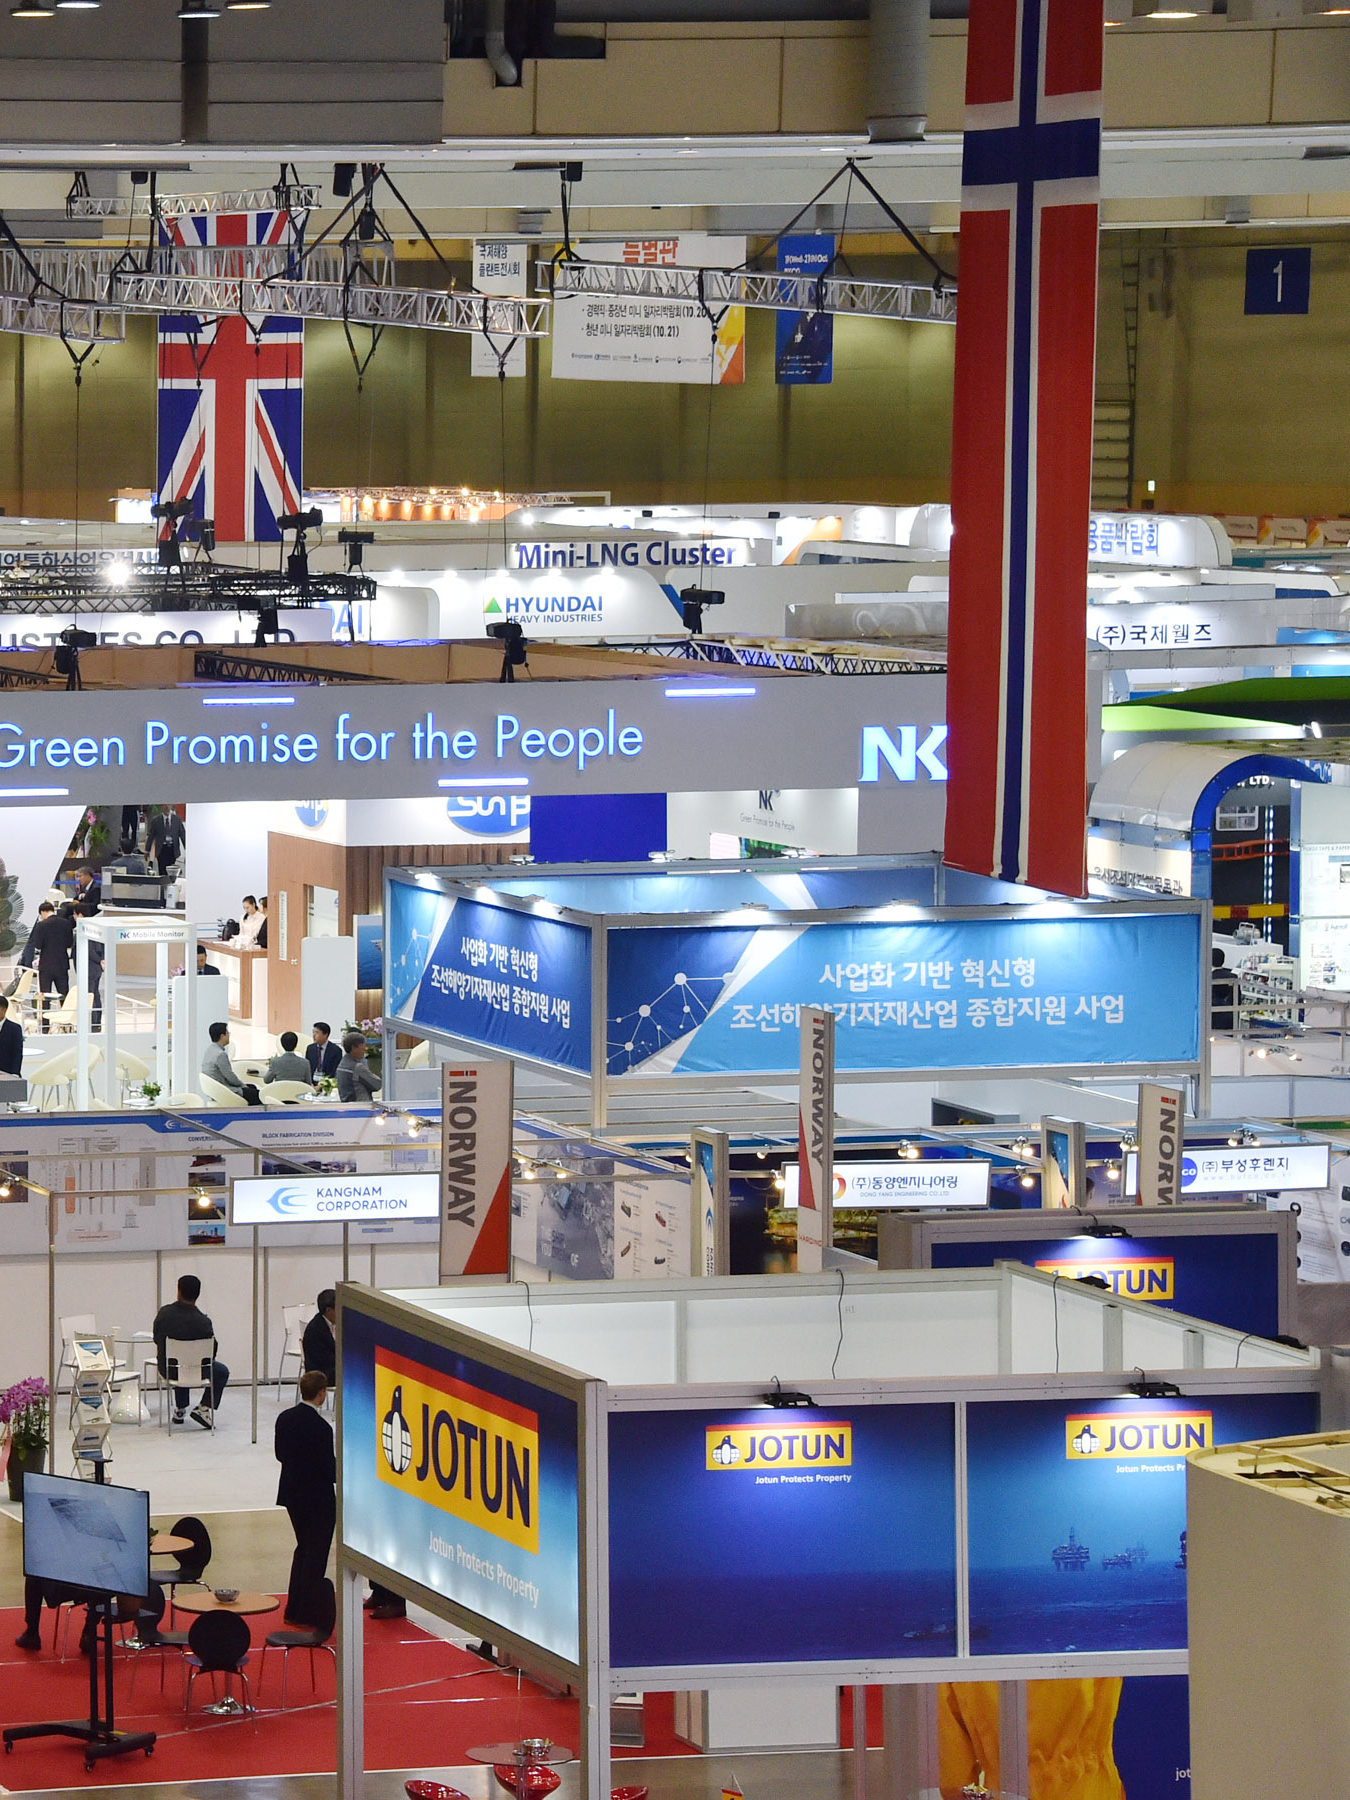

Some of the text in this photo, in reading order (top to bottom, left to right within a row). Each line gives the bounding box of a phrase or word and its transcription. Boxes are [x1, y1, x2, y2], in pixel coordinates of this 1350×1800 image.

[1272, 260, 1283, 302] 1
[518, 540, 736, 568] Mini-LNG Cluster
[505, 595, 603, 613] HYUNDAI
[505, 613, 603, 624] HEAVY INDUSTRIES
[145, 720, 318, 765] Promise
[336, 712, 396, 762] for
[413, 711, 478, 760] the
[495, 708, 645, 770] People
[858, 724, 948, 782] NK
[759, 790, 773, 811] NK
[461, 936, 538, 983] 사업화 기반 혁신형
[819, 957, 1036, 990] 사업화 기반 혁신형
[431, 964, 571, 1029] 조선해양기자재산업 종합지원 사업
[966, 996, 1067, 1026] 종합지원
[1073, 993, 1125, 1022] 사업
[811, 1029, 825, 1167] NORWAY
[447, 1081, 477, 1228] NORWAY
[1158, 1107, 1177, 1206] NORW
[316, 1186, 382, 1198] KANGNAM
[851, 1175, 958, 1190] (주)동양엔지니어링
[316, 1199, 408, 1212] CORPORATION
[744, 1433, 845, 1463] JOTUN
[1105, 1423, 1205, 1452] JOTUN
[416, 1403, 531, 1529] JOTUN
[755, 1474, 853, 1485] Jotun Protects Property
[1116, 1465, 1139, 1474] Jotun
[1141, 1464, 1175, 1472] Protects
[429, 1532, 539, 1608] Jotun Protects Property
